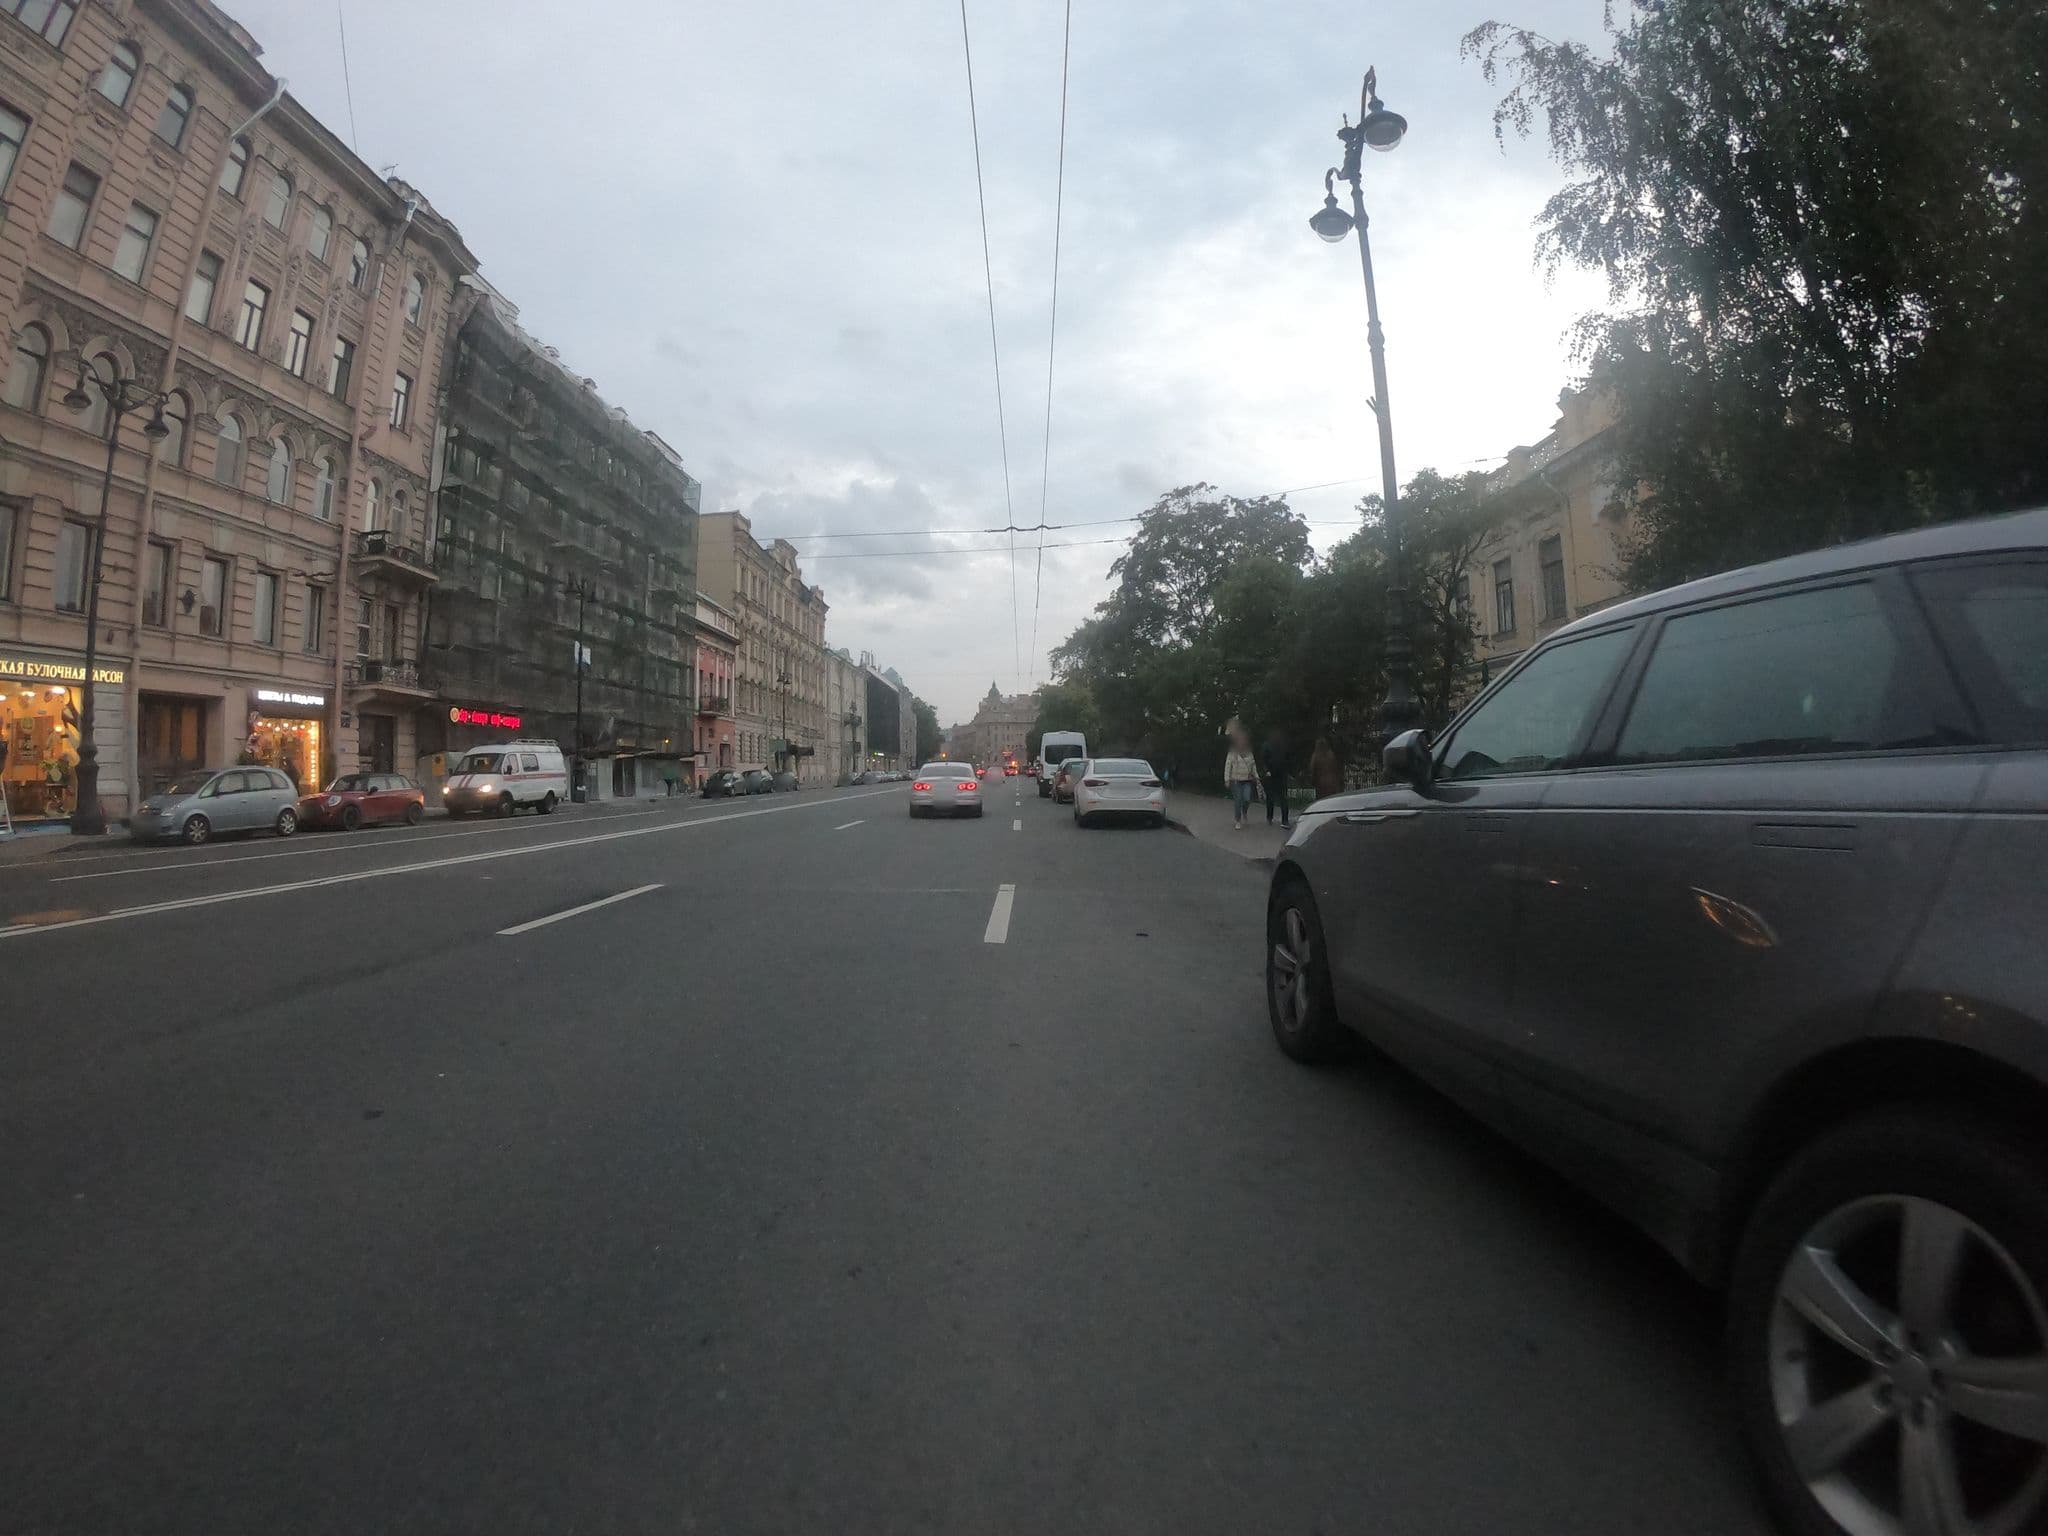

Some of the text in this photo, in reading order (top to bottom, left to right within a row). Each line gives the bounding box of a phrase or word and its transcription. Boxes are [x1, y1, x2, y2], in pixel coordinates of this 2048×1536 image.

[0, 661, 124, 683] КАЯ БУЛОЧНАЯ АРСОН
